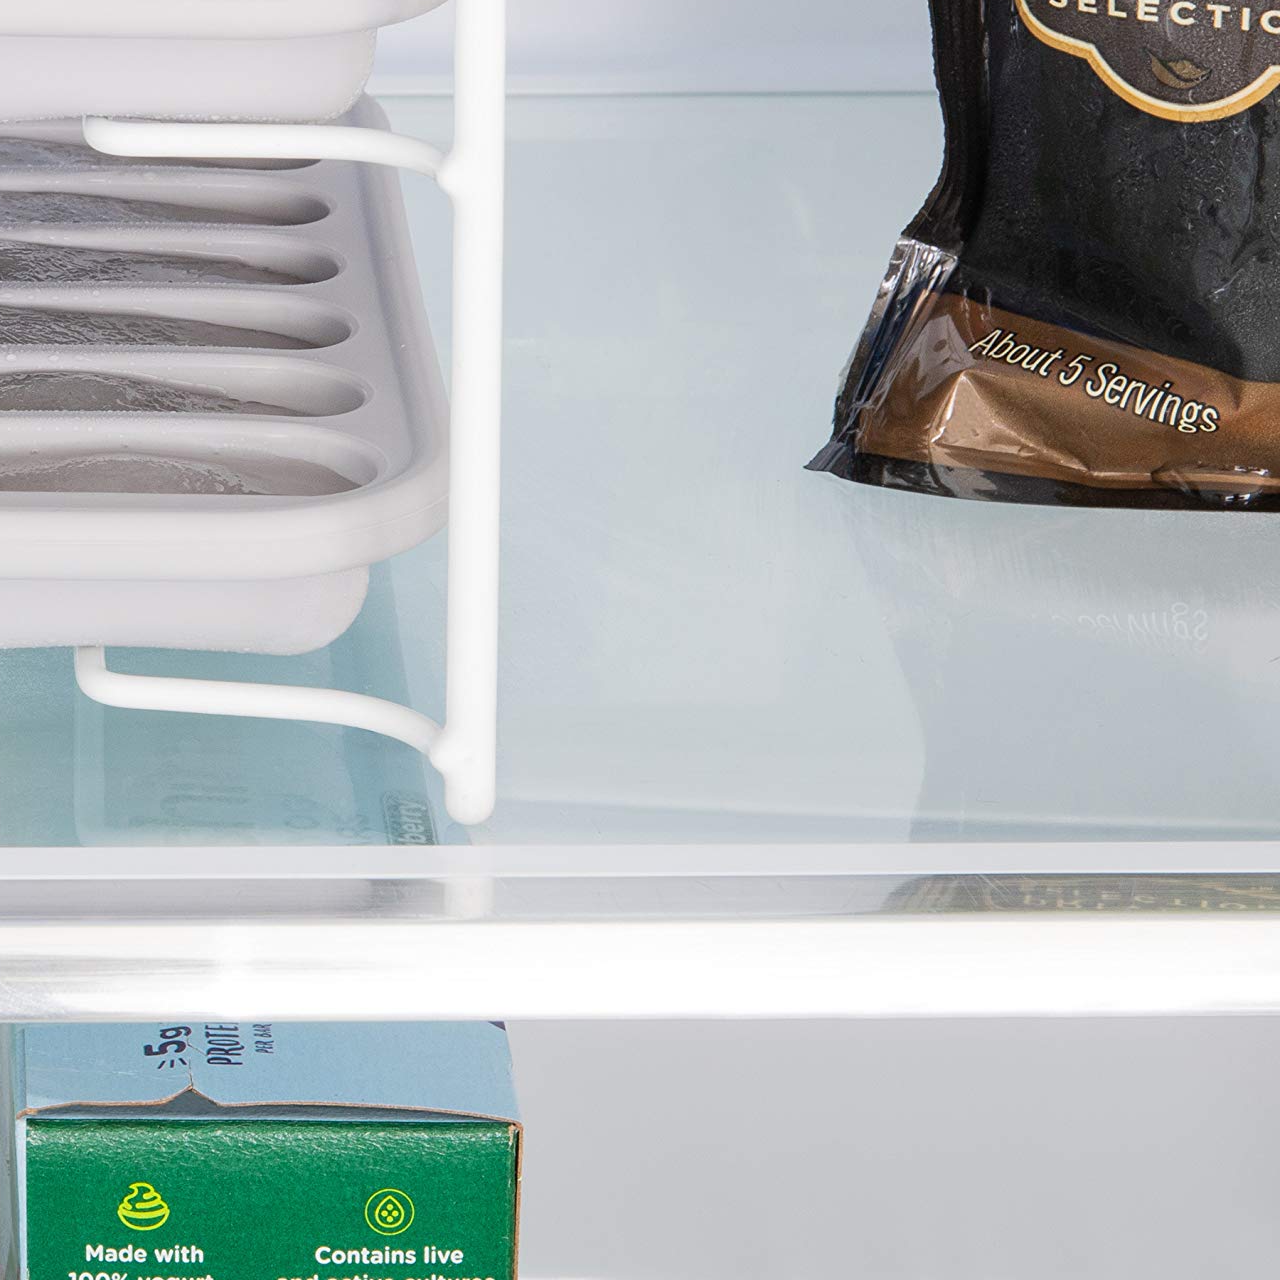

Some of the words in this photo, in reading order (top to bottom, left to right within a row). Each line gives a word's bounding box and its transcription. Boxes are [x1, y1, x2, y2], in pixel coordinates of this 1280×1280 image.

[968, 328, 1063, 377] About
[1059, 354, 1093, 386] 5
[1085, 363, 1220, 434] Servings
[252, 1023, 273, 1038] BAR
[143, 1025, 192, 1057] 5g
[254, 1040, 275, 1054] PER
[85, 1244, 148, 1263] Made
[154, 1244, 205, 1263] with
[314, 1245, 417, 1265] Contains
[423, 1246, 465, 1265] live
